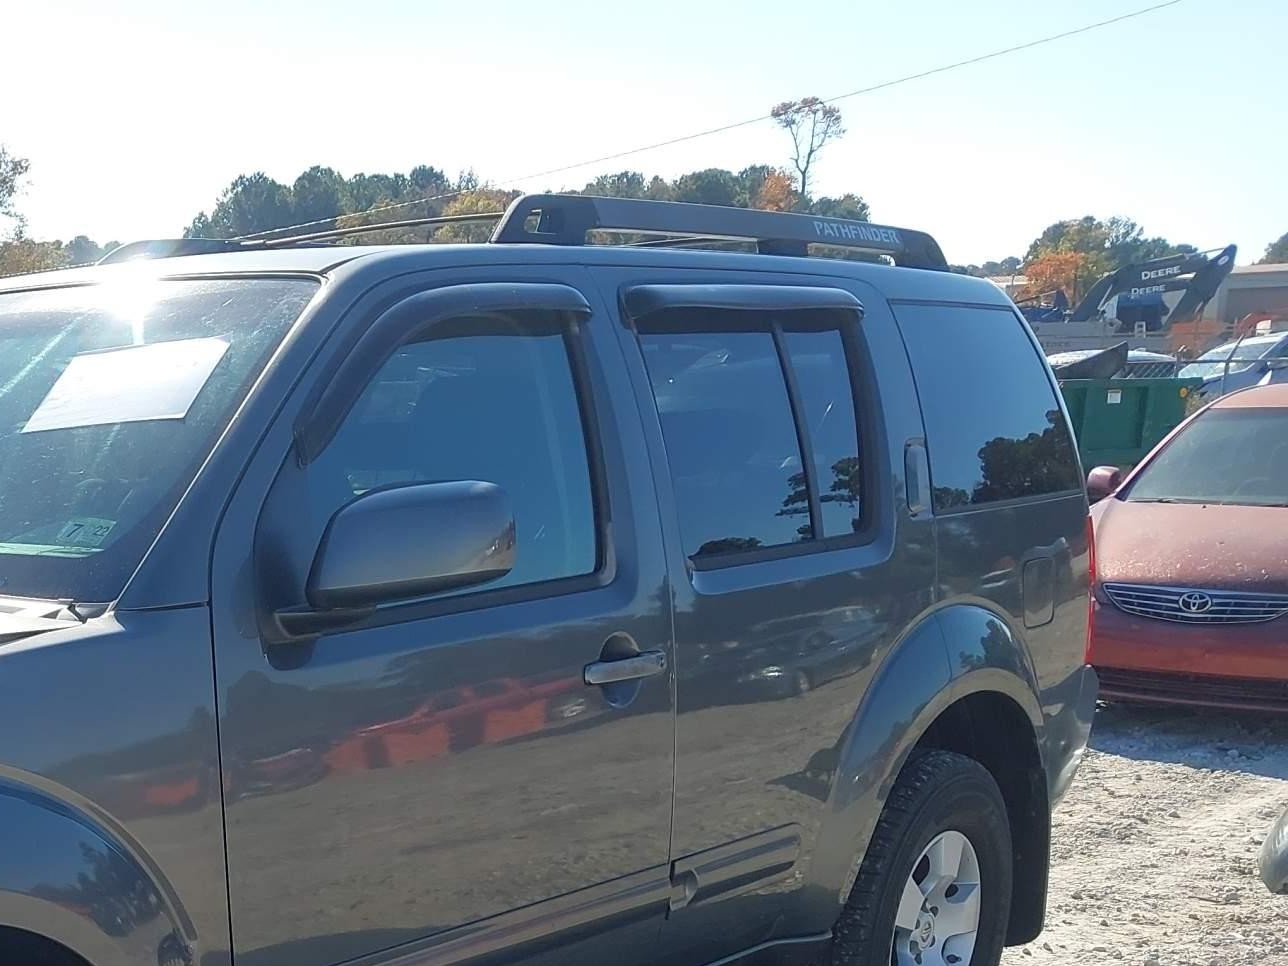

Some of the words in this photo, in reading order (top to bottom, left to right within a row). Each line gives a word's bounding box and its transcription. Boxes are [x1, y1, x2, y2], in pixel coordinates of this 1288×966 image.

[813, 221, 899, 244] PATHFINDER
[1141, 265, 1181, 280] DEERE
[1131, 284, 1166, 295] DEERE
[66, 523, 85, 537] 7
[93, 525, 110, 536] 22
